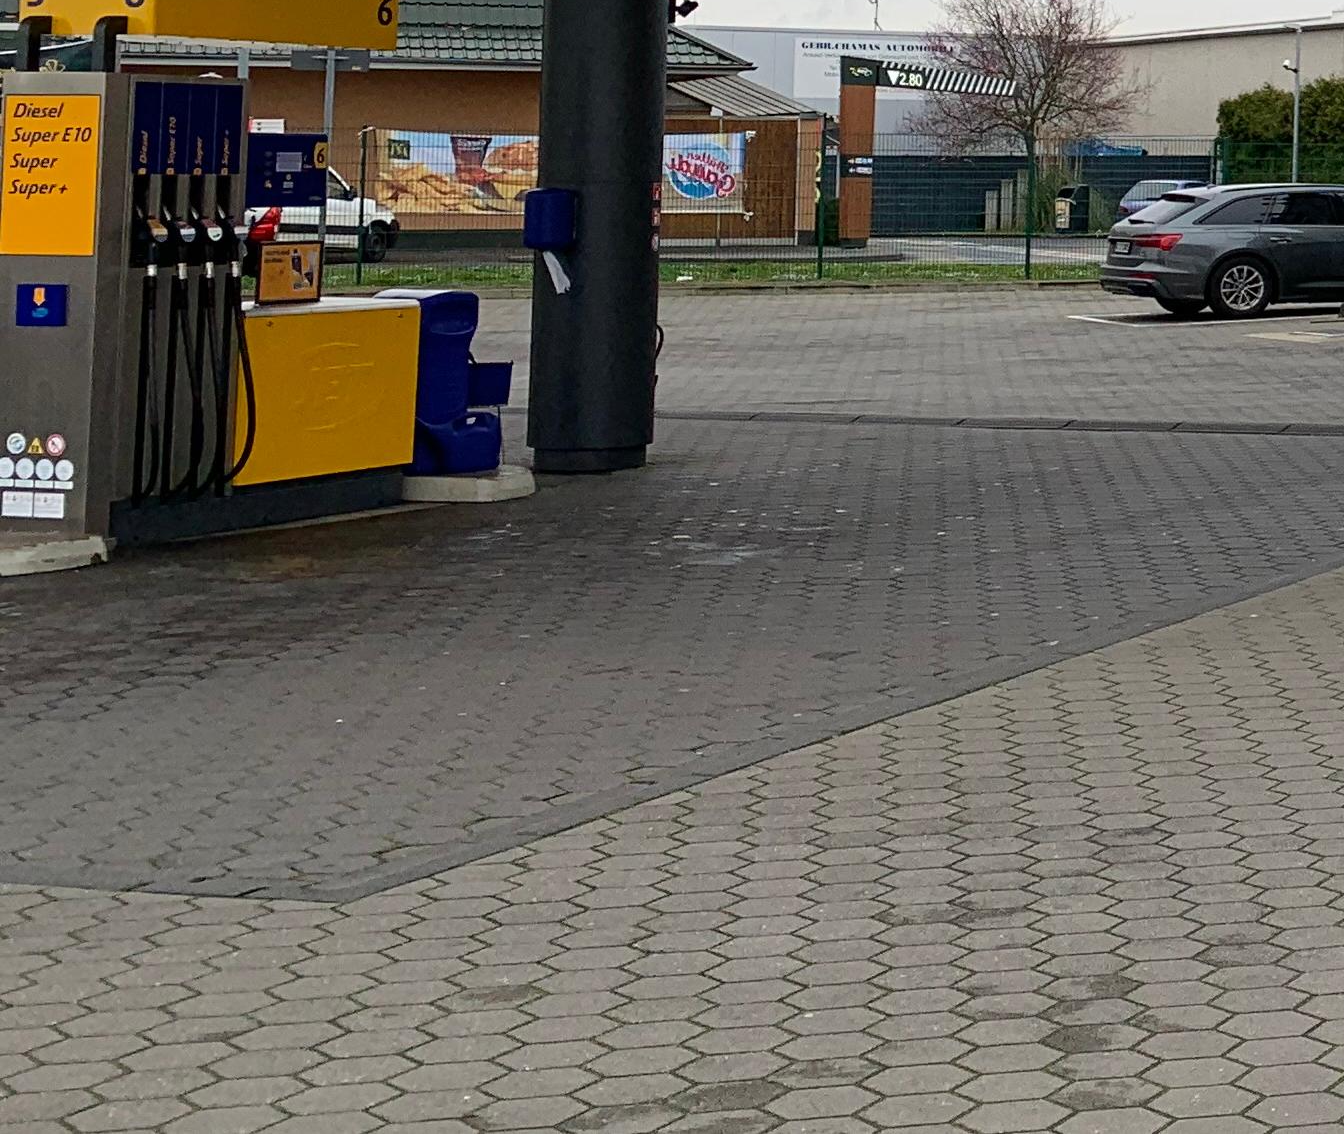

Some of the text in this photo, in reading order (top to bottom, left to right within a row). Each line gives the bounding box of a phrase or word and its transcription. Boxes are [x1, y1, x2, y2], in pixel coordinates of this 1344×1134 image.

[900, 72, 923, 87] 2.80
[13, 102, 64, 118] Diesel
[11, 127, 92, 147] Super E10
[10, 153, 58, 173] Super
[316, 148, 326, 164] 6
